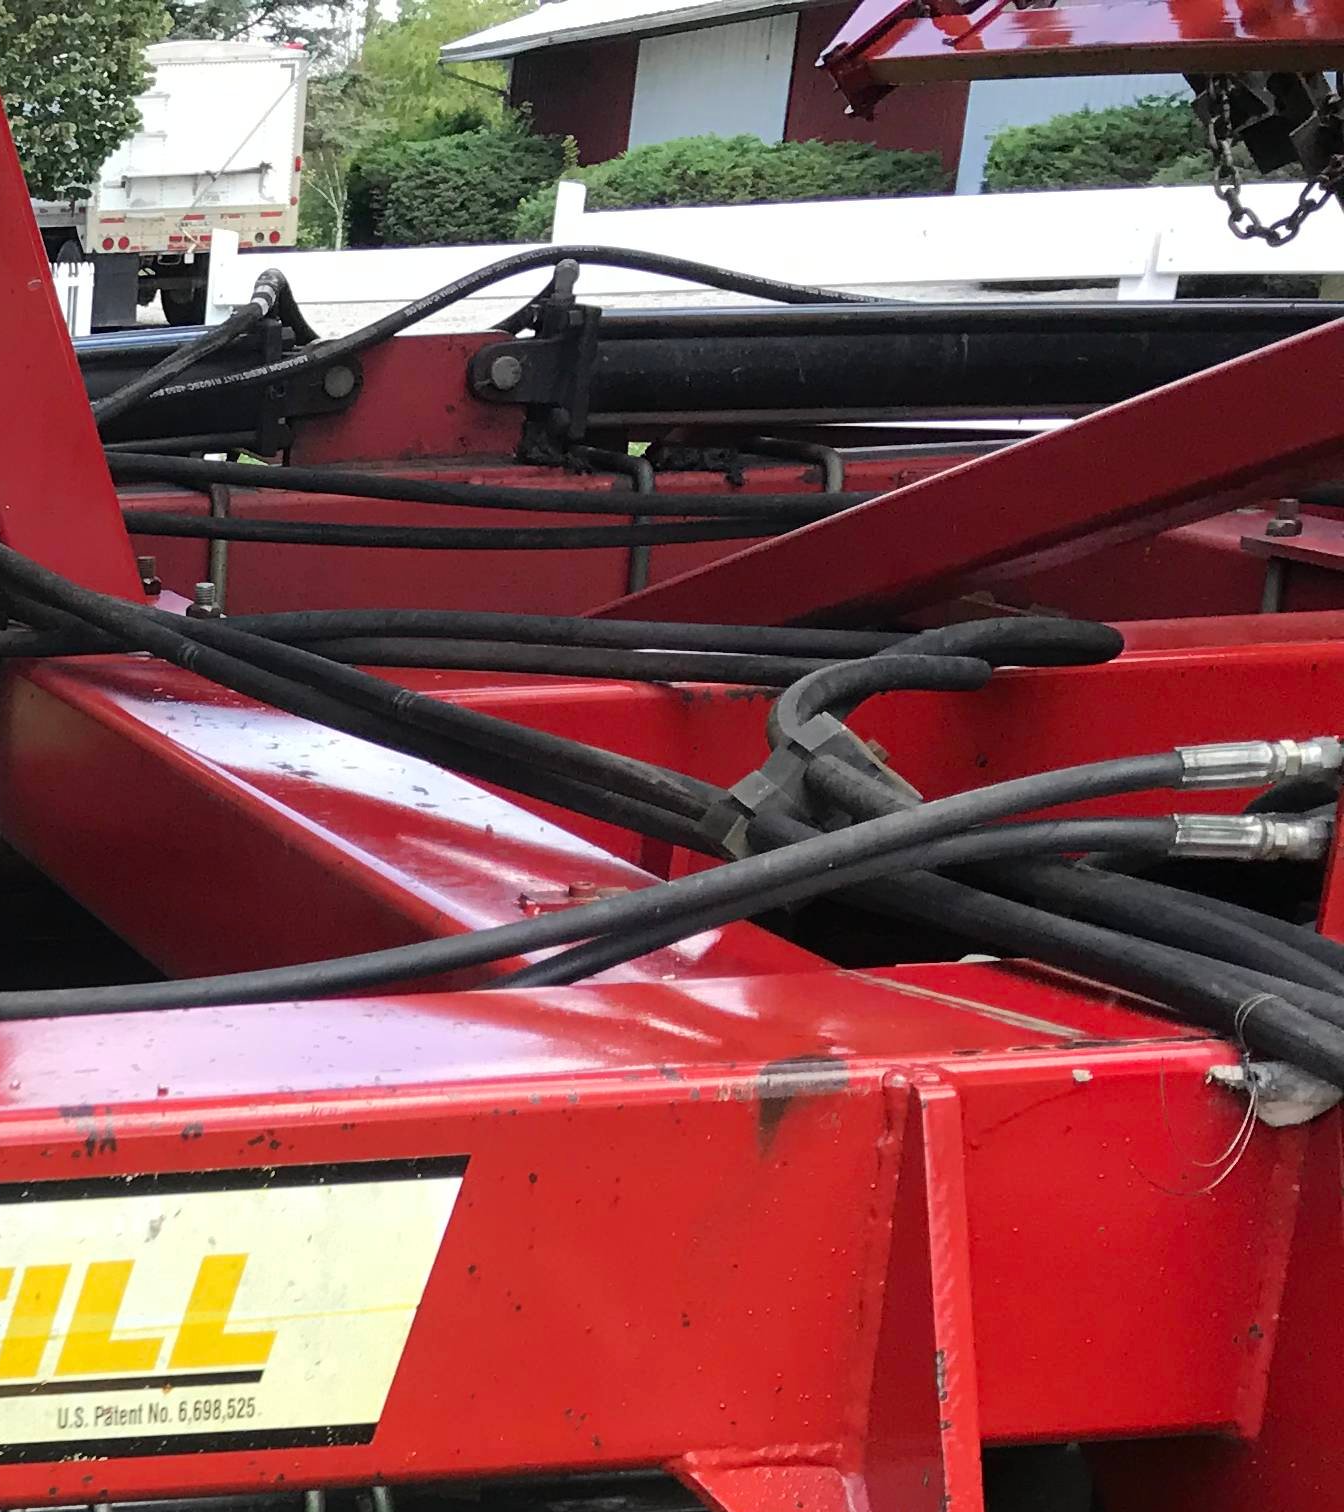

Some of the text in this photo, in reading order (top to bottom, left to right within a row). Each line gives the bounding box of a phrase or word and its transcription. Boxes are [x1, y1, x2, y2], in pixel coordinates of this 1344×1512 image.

[57, 1406, 90, 1429] U.S.
[94, 1404, 143, 1427] Patent
[148, 1402, 173, 1424] No.
